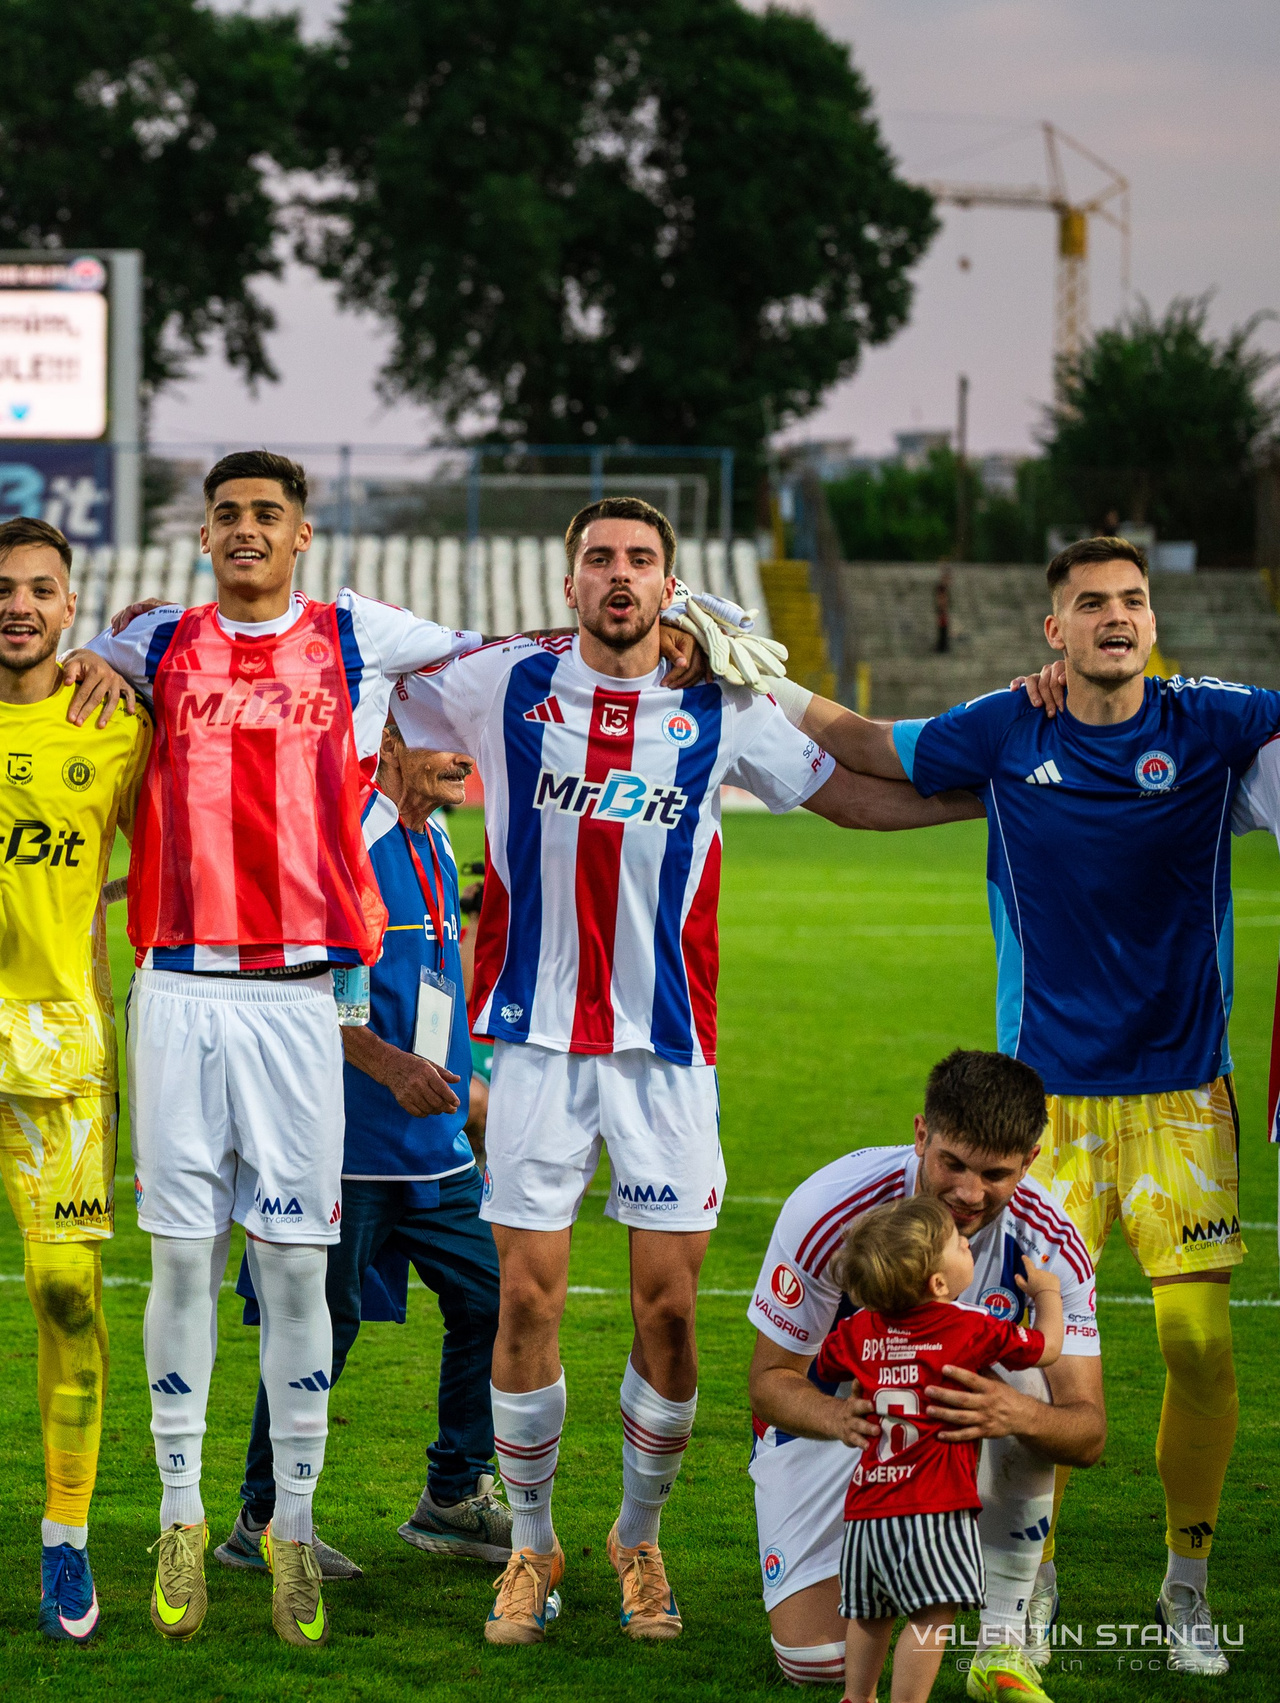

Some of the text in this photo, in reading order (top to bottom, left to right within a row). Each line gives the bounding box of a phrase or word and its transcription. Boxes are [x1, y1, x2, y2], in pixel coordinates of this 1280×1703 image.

[534, 772, 683, 826] MrBit
[618, 1181, 679, 1203] MMA
[649, 1203, 679, 1212] GROUP
[55, 1217, 94, 1229] SECURITY
[275, 1216, 303, 1224] GROUP
[1182, 1215, 1241, 1245] MMA
[1184, 1239, 1224, 1254] SECURITY
[754, 1293, 810, 1342] VALGRIG
[878, 1364, 920, 1385] JACOB
[872, 1387, 920, 1464] 6
[524, 1489, 538, 1502] 15
[659, 1482, 671, 1496] 15
[1190, 1535, 1203, 1549] 13
[1016, 1598, 1025, 1612] 6
